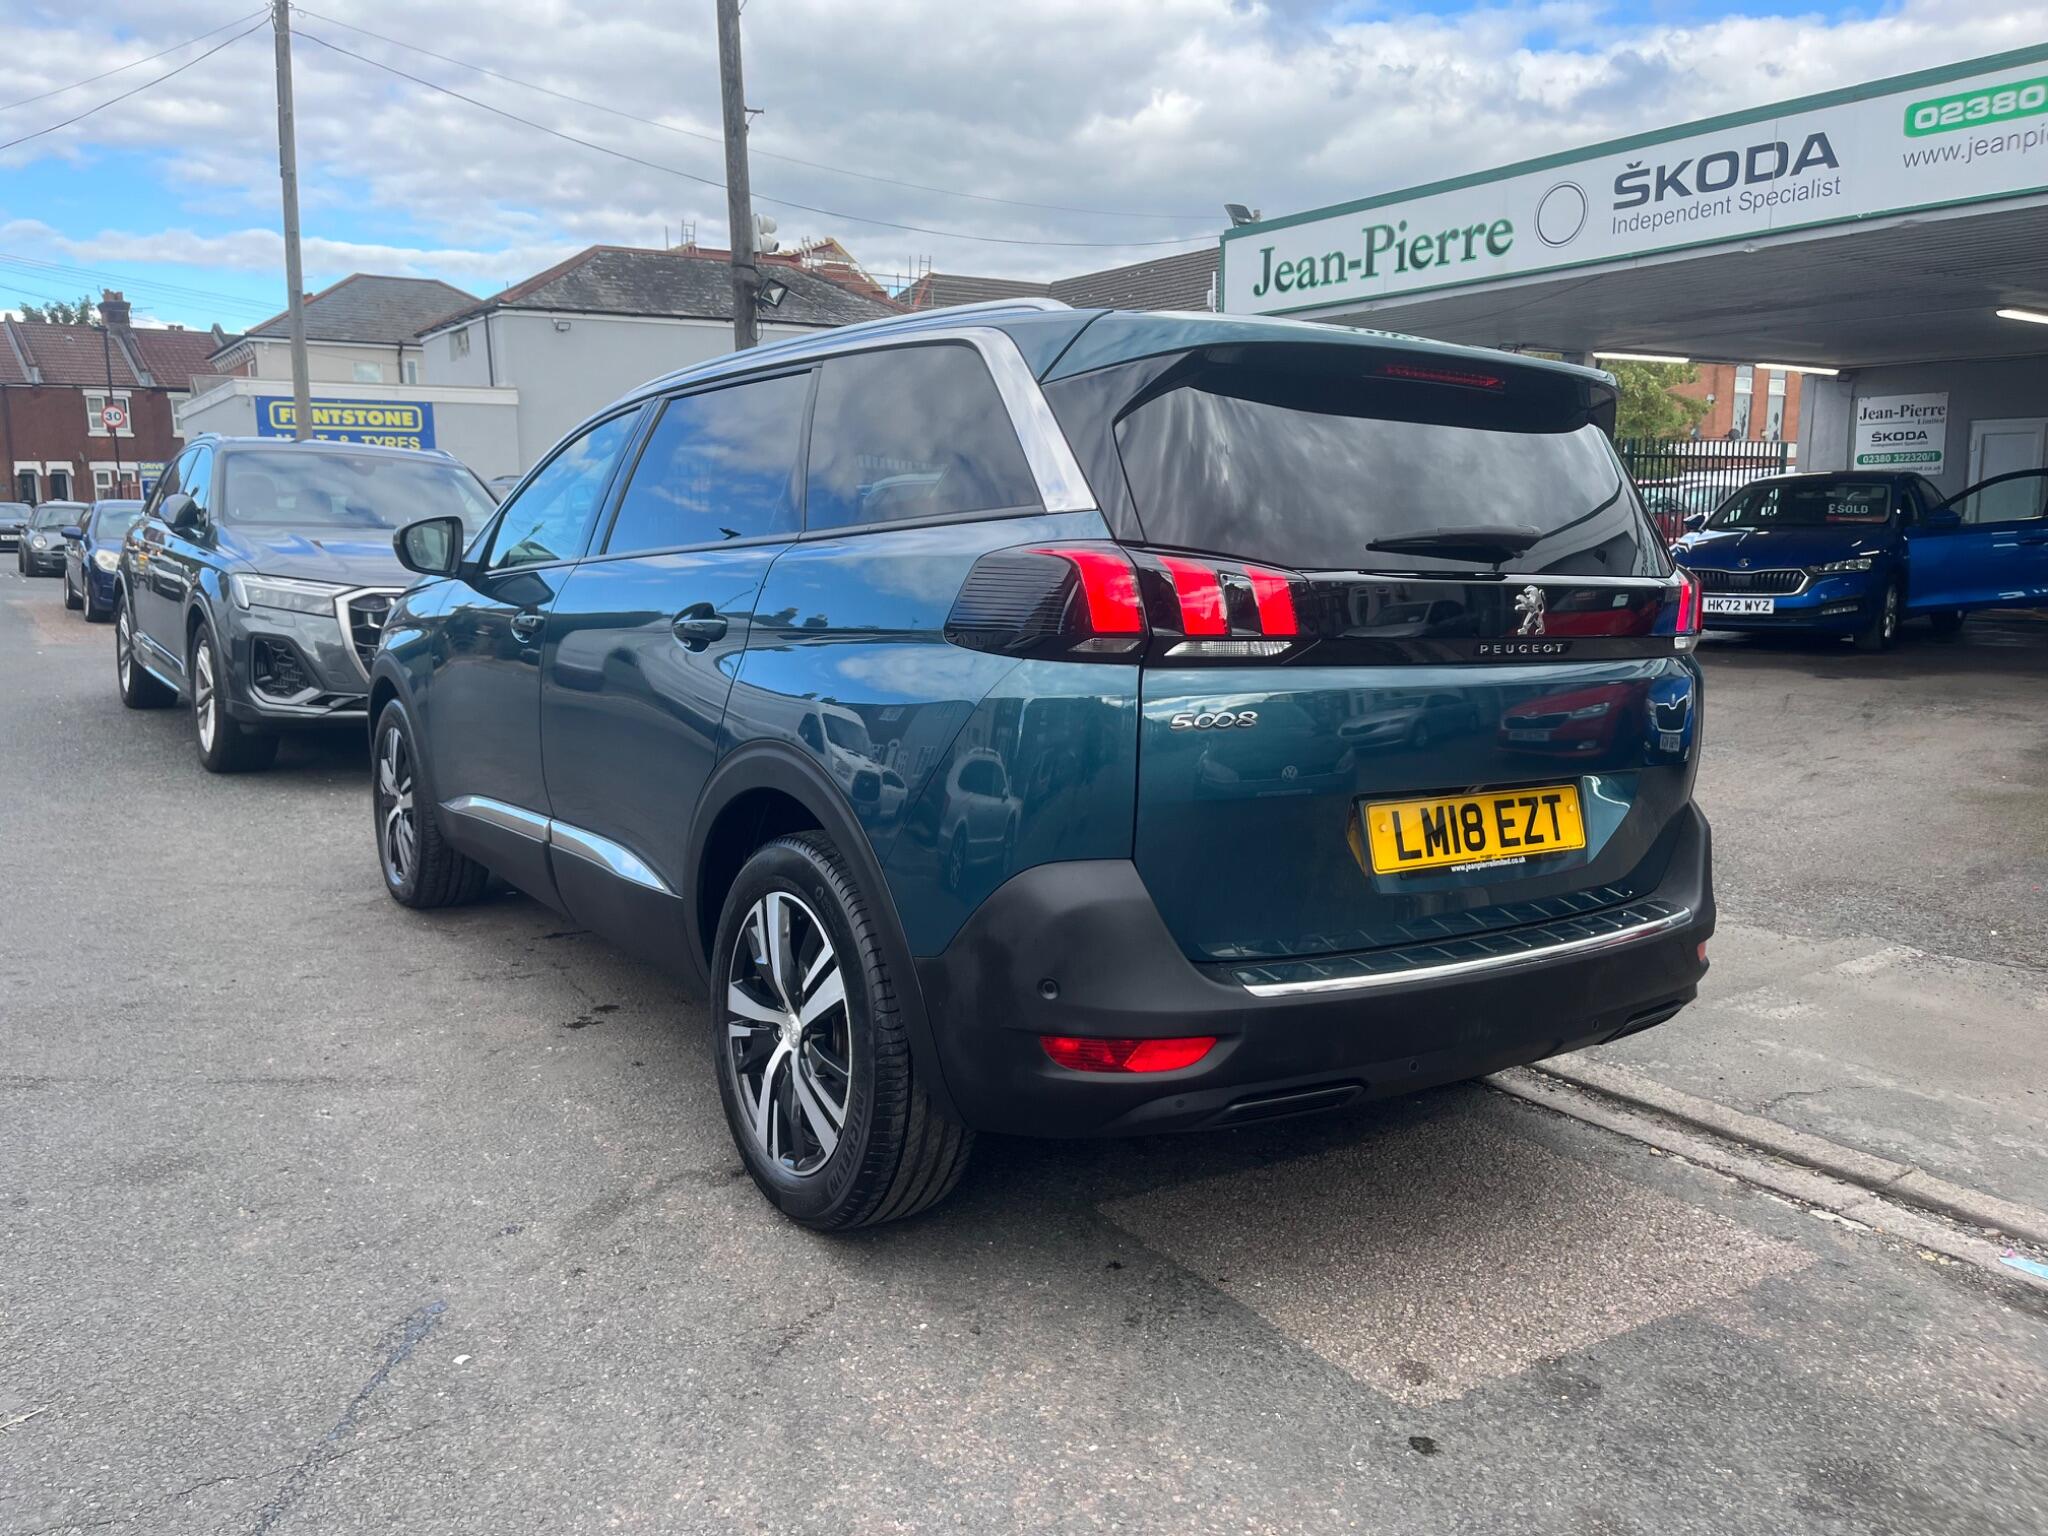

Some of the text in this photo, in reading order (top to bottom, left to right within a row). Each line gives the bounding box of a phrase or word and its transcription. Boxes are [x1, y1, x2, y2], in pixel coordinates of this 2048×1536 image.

[1914, 84, 2046, 129] 02380
[1902, 122, 2048, 168] www.jeanpi
[1612, 131, 1840, 211] ŠKODA
[1611, 176, 1841, 235] Independent Specialist
[1252, 217, 1515, 298] Jean-Pierre
[105, 411, 122, 421] 30
[278, 407, 415, 427] FNTSTONE
[1859, 403, 1946, 421] Jean-Pierre
[1871, 430, 1928, 443] ŠKODA
[1862, 454, 1891, 464] 02380
[1707, 599, 1771, 612] HK72 WYZ
[1479, 643, 1564, 654] PEUGEOT
[1169, 710, 1259, 730] 5008
[1391, 794, 1562, 862] LM18 EZT
